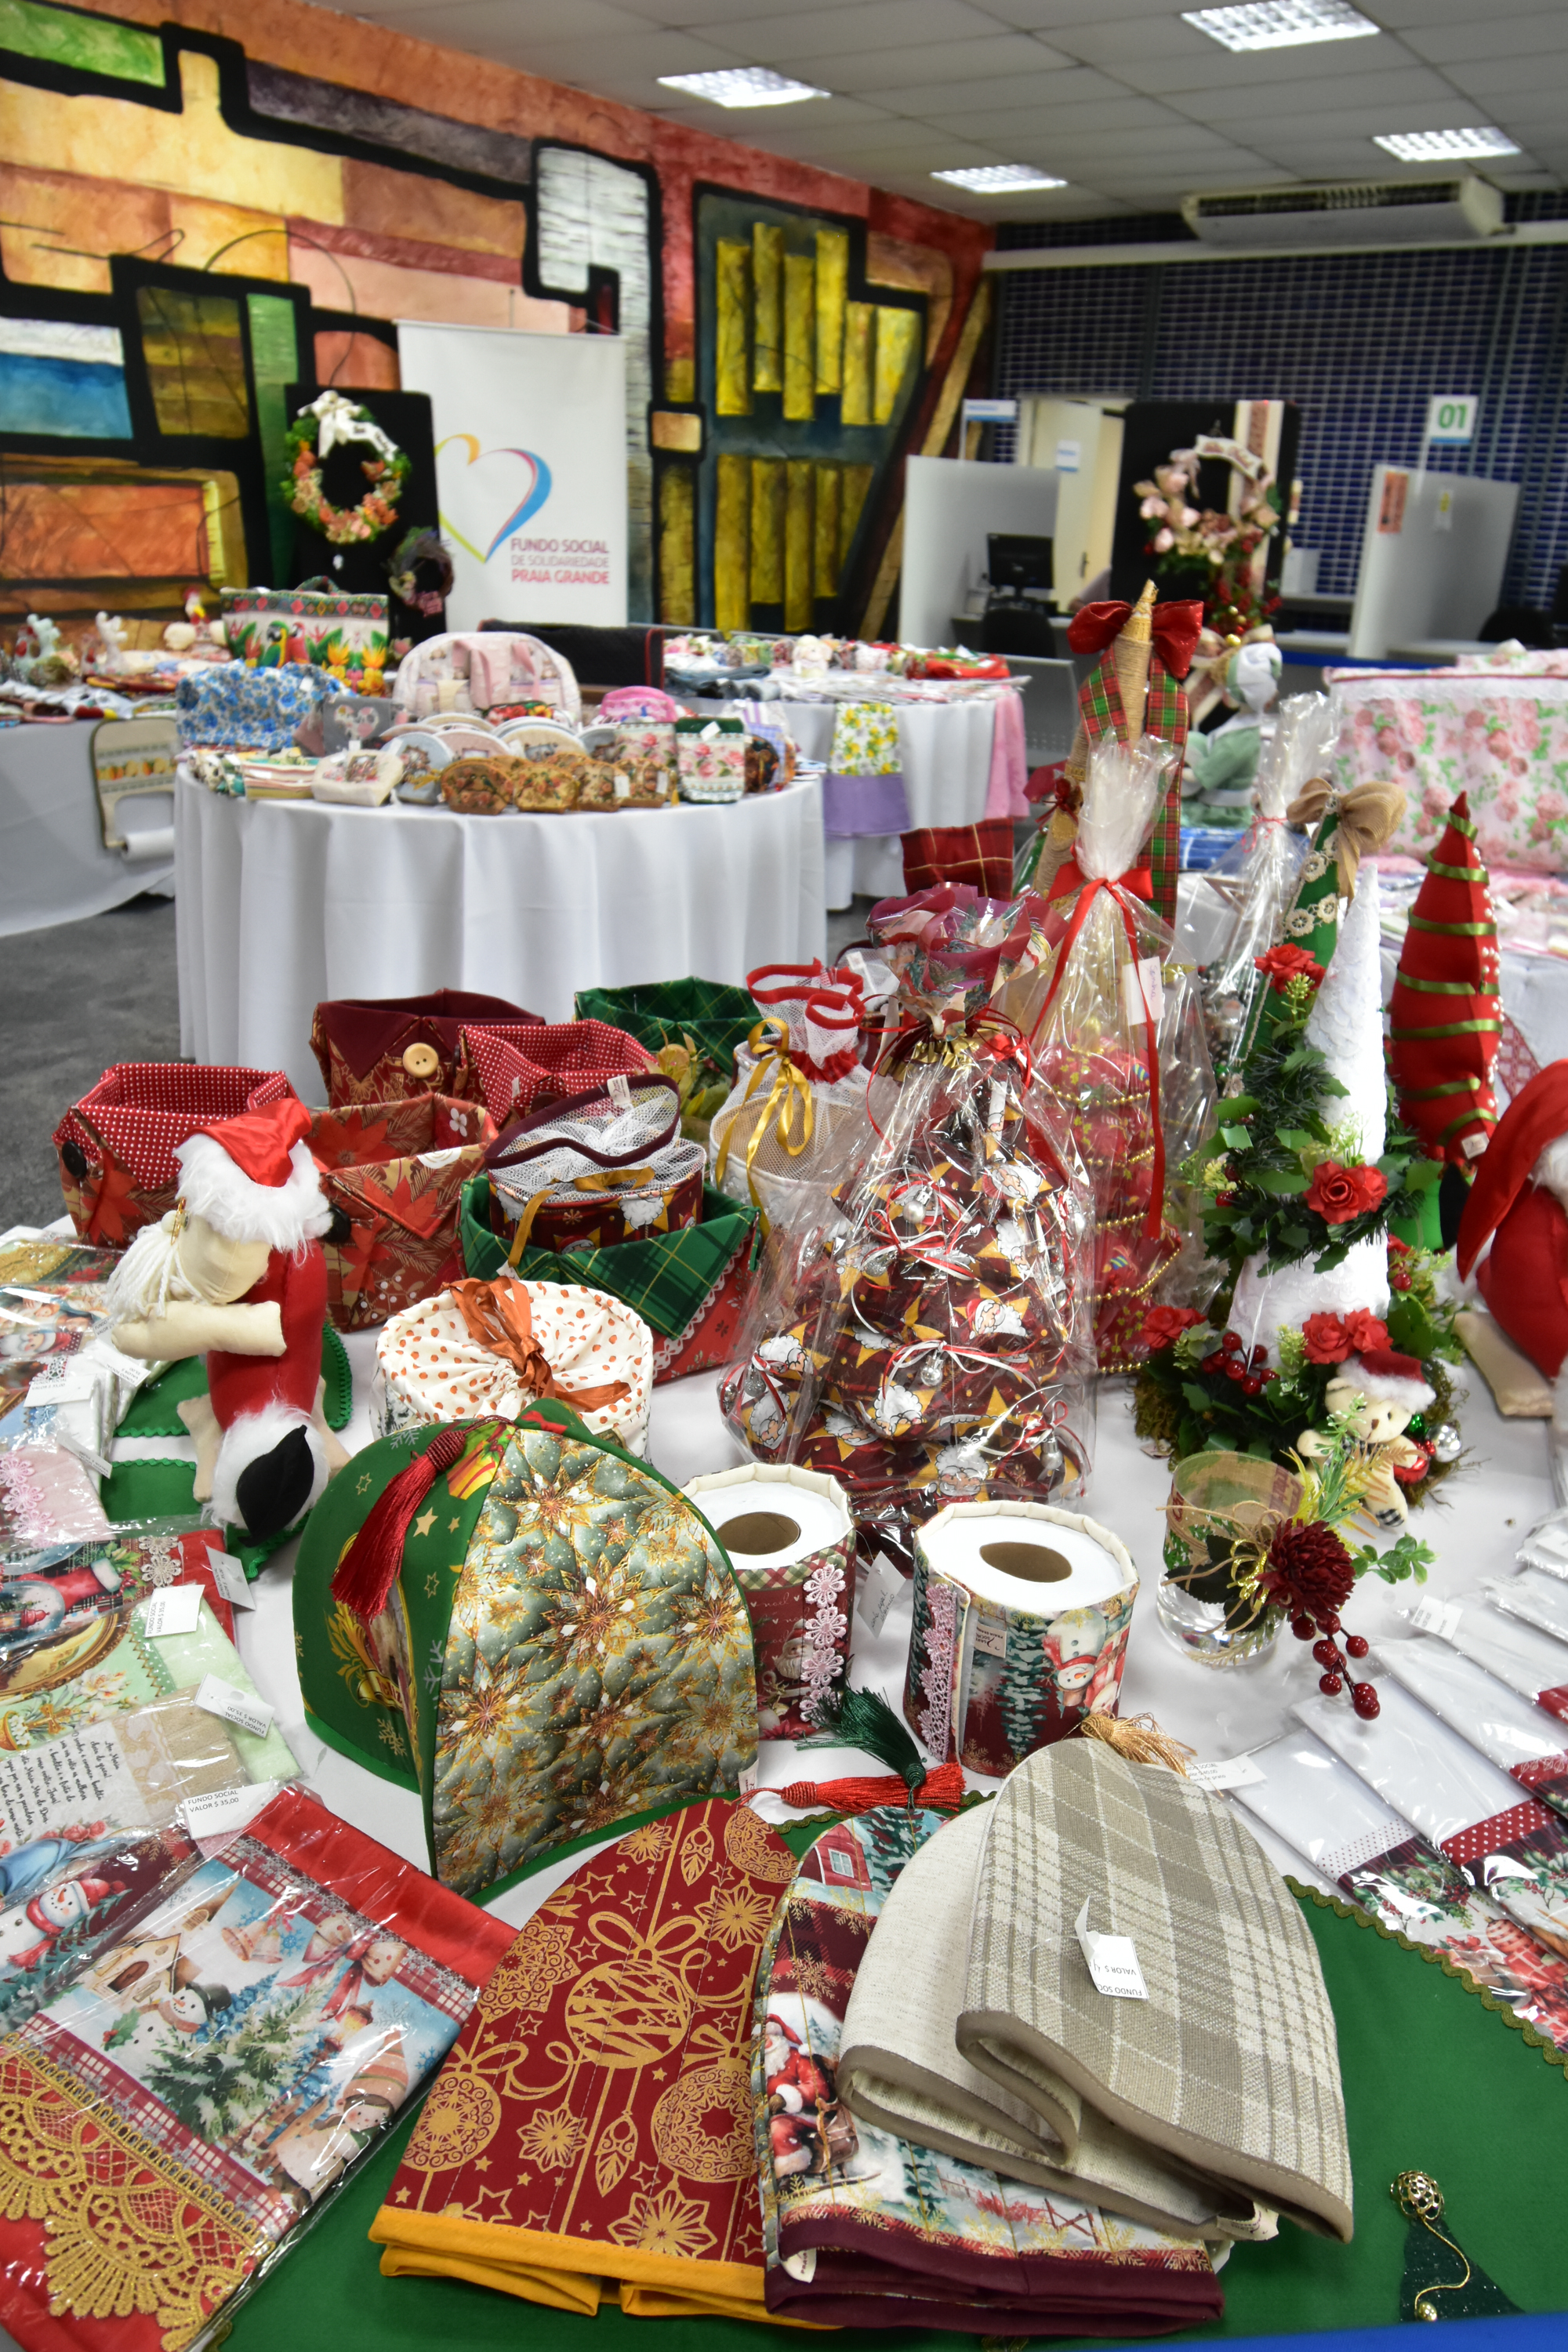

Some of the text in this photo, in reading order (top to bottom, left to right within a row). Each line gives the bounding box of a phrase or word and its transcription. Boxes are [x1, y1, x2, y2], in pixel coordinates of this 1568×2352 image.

[1438, 403, 1468, 429] 01
[511, 538, 609, 554] FUNDO SOCIAL
[511, 554, 609, 568] DE SOLIDARIEDADE
[512, 568, 609, 584] PRAIA GRANDE
[95, 1319, 107, 1330] FUNDO
[764, 1592, 789, 1607] noel
[150, 1602, 158, 1617] SOCIAL
[227, 1706, 244, 1716] 35,00
[225, 1711, 264, 1734] FUNDO SOCIAL
[248, 1716, 267, 1728] VALOR
[187, 1789, 238, 1805] FUNDO SOCIAL
[189, 1803, 213, 1813] VALOR
[220, 1797, 239, 1806] 35,00
[1112, 1966, 1137, 1976] VALOR
[1114, 1987, 1142, 1996] FUNDO
